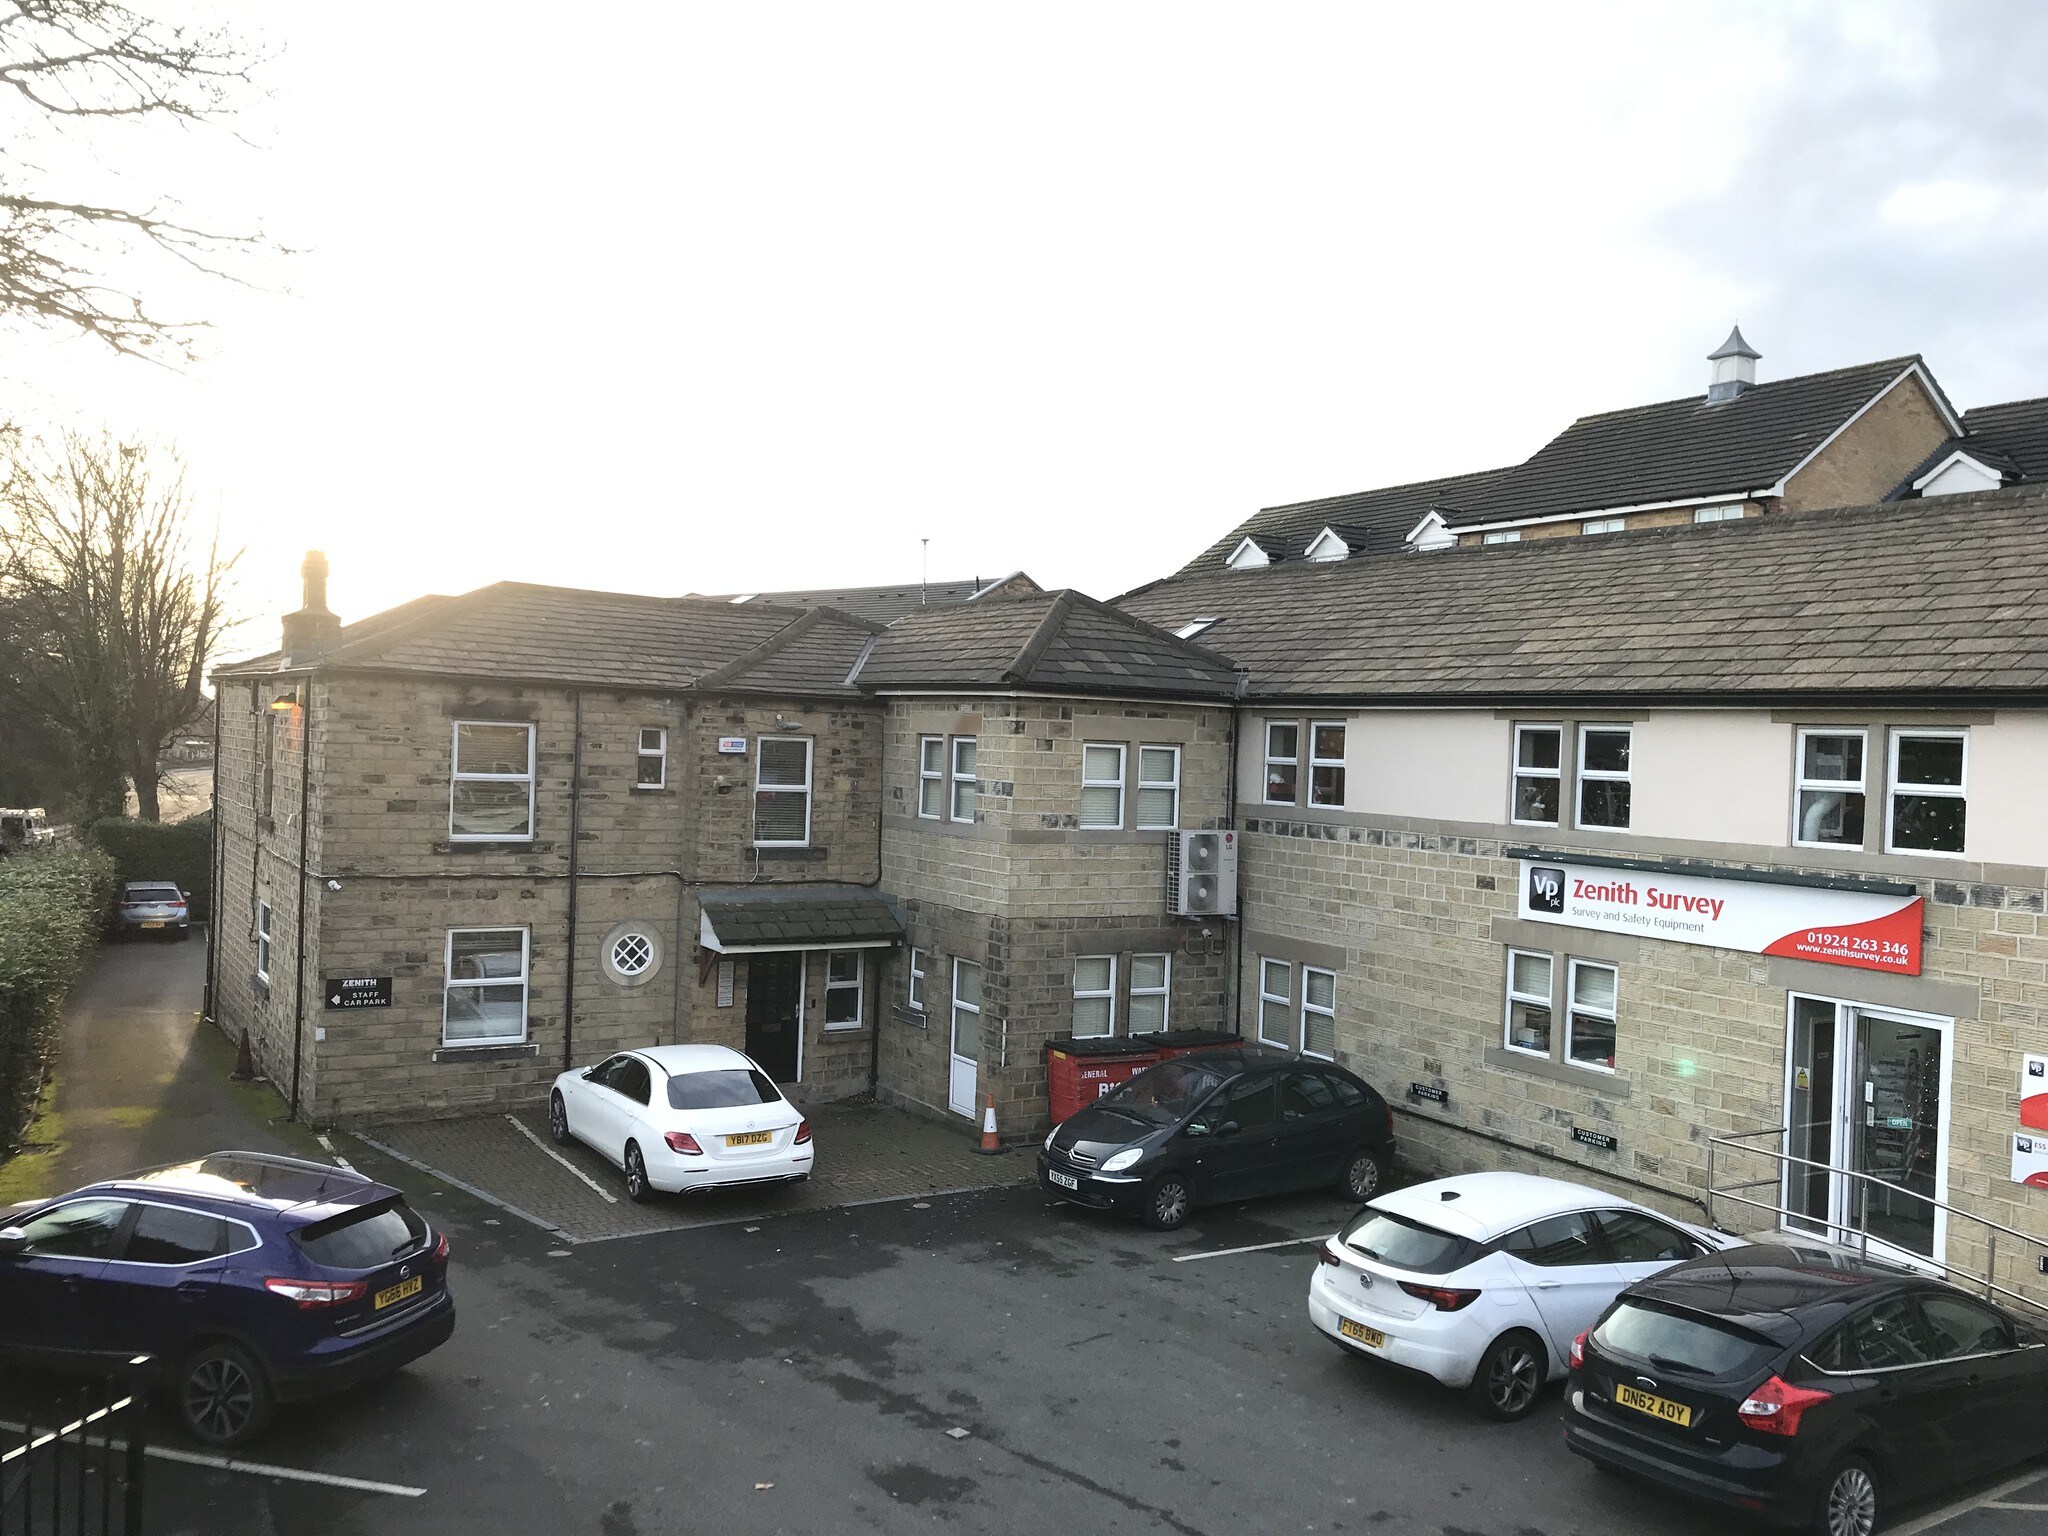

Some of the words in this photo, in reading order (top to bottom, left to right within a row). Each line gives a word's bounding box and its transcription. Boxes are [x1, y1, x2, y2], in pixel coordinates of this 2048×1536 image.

[1533, 875, 1559, 901] Vp
[1550, 897, 1560, 907] plc
[1573, 879, 1638, 906] Zenith
[1647, 887, 1725, 921] Survey
[1571, 906, 1601, 921] Survey
[1603, 911, 1620, 922] and
[1622, 913, 1651, 927] Safety
[1654, 917, 1705, 933] Equipment
[1807, 932, 1849, 948] 01924
[1852, 937, 1878, 952] 263
[1882, 941, 1909, 956] 346
[1796, 943, 1909, 966] www.zenithsurvey.co.uk
[342, 979, 377, 987] ZENITH
[352, 991, 379, 999] STAFF
[363, 998, 387, 1006] PARK
[1891, 1119, 1908, 1127] OPEN
[730, 1135, 750, 1145] YB17
[751, 1133, 767, 1143] DZG
[1577, 1129, 1610, 1143] CUSTOMER
[1580, 1135, 1607, 1148] PARKING
[2034, 1142, 2047, 1150] ESS
[1342, 1319, 1364, 1338] FT65
[1365, 1328, 1383, 1345] BWO
[1622, 1388, 1656, 1412] DN62
[1658, 1401, 1685, 1422] AOY
